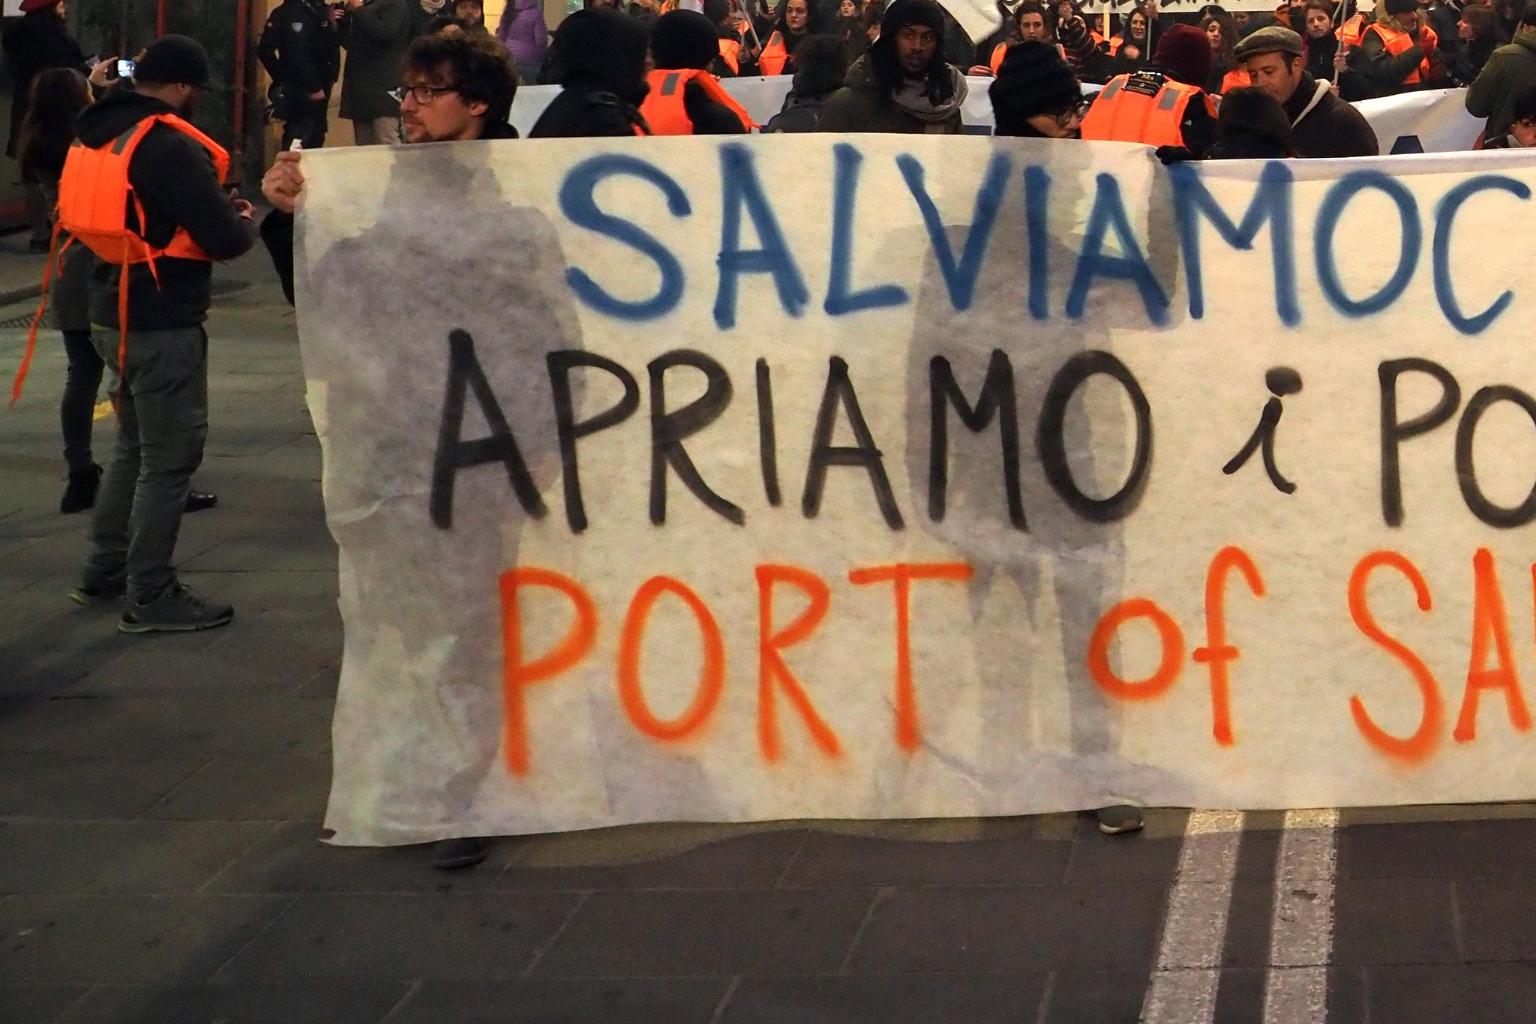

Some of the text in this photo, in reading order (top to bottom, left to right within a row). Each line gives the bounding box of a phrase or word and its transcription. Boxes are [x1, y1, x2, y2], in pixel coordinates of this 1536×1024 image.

[429, 329, 1153, 534] APRIAMO
[499, 562, 975, 778] PORT
[1087, 545, 1267, 748] of
